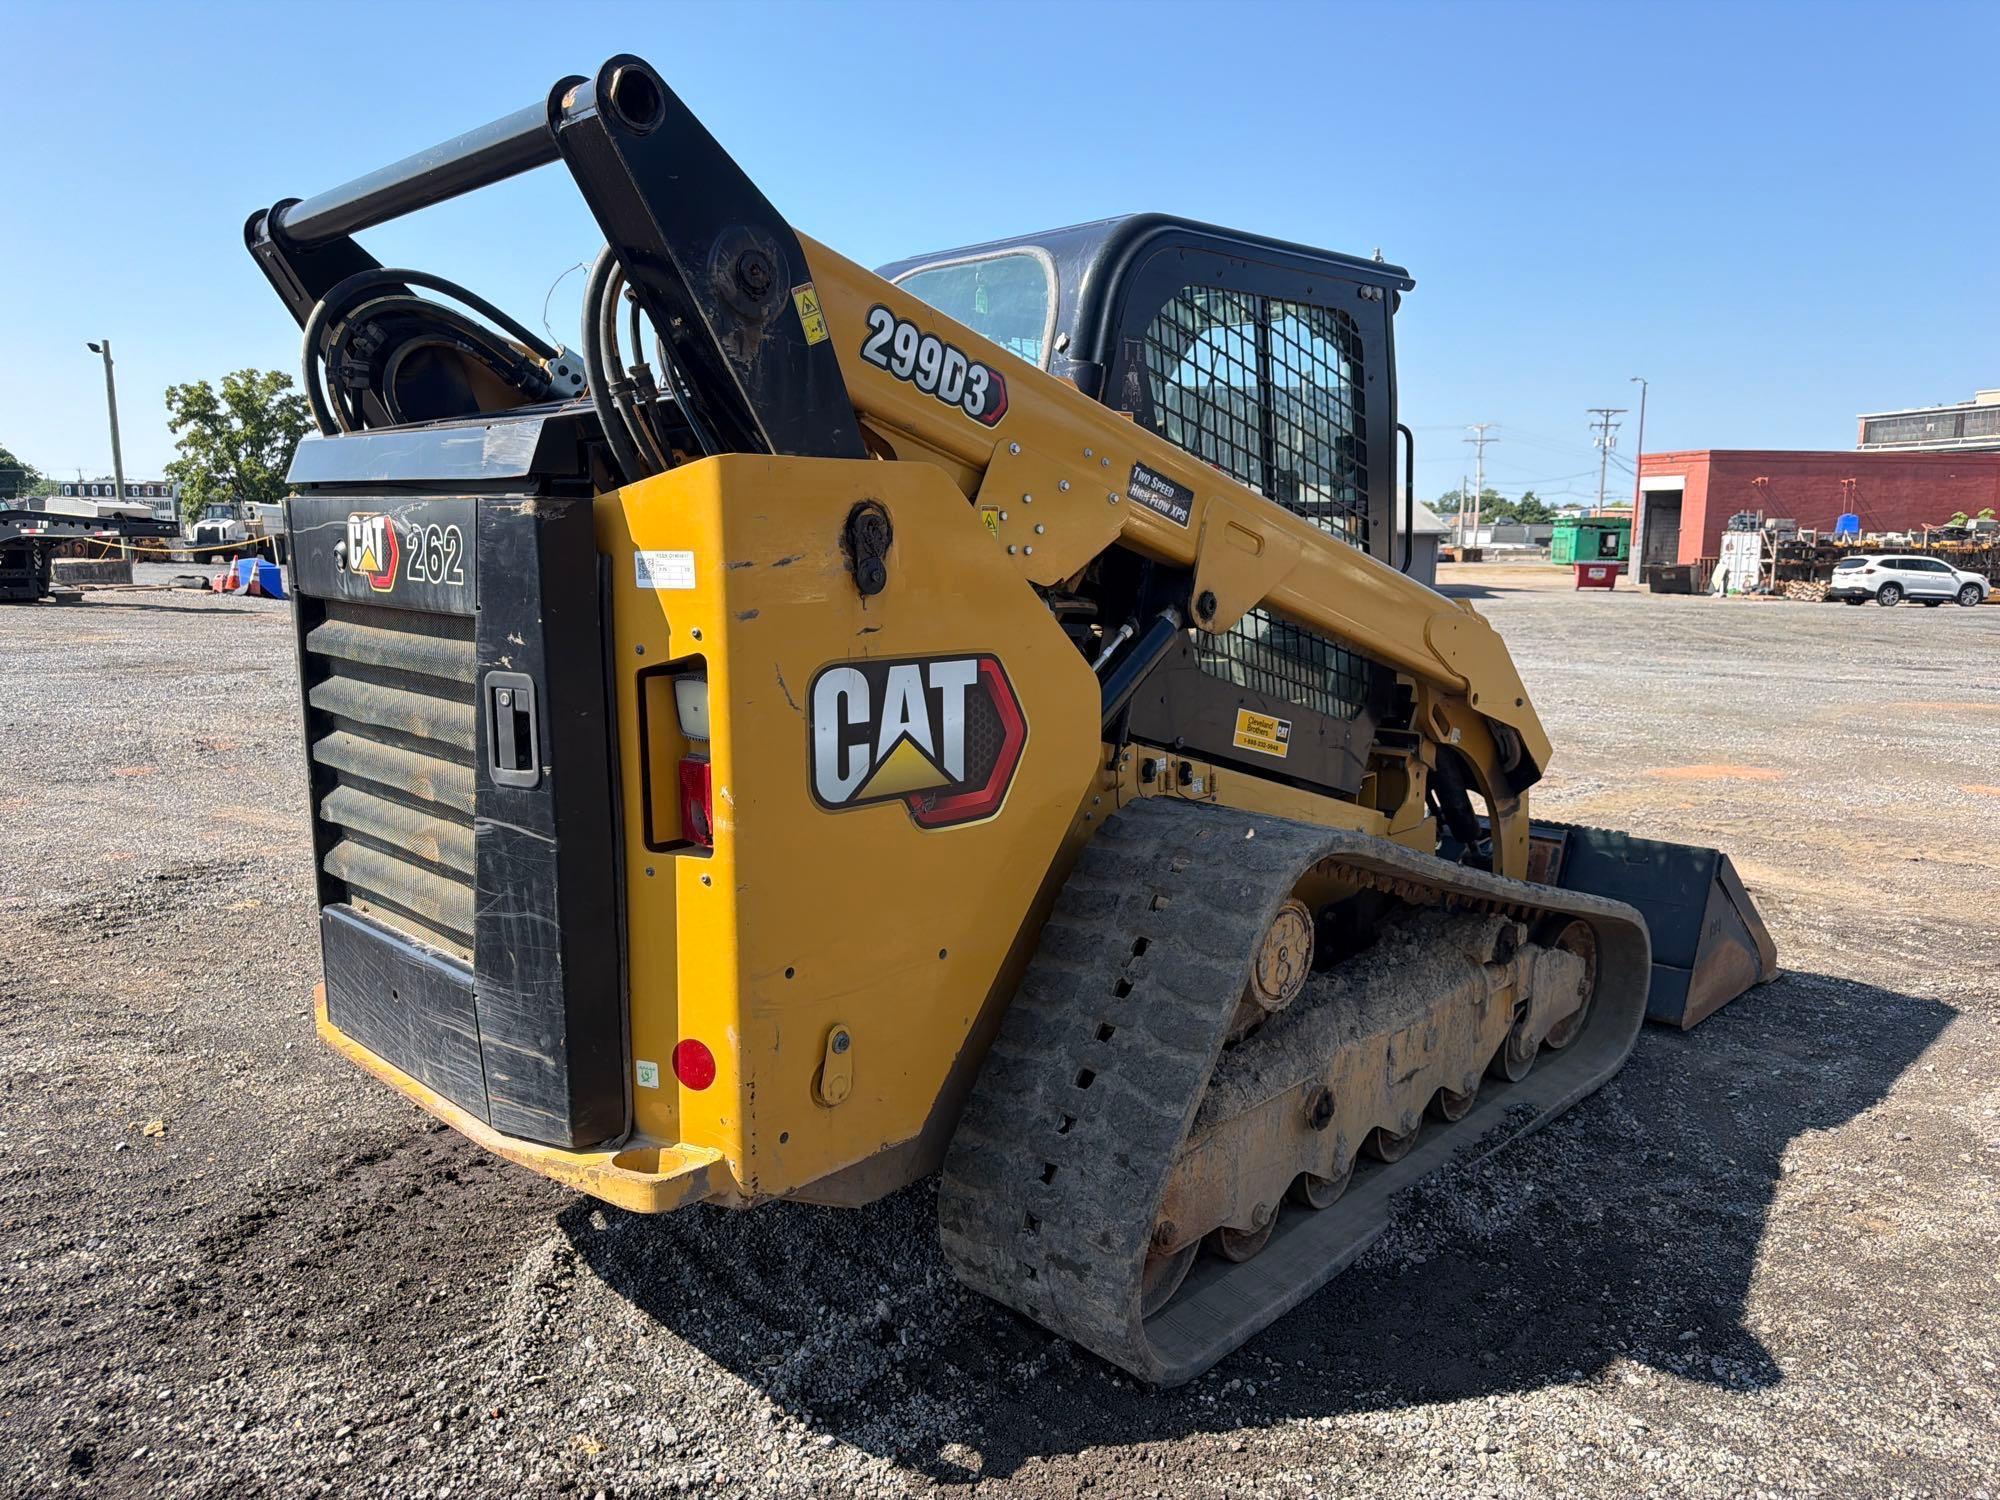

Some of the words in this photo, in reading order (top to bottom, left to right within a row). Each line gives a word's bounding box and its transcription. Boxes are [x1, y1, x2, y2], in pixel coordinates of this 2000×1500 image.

[863, 308, 990, 416] 299D3
[1133, 466, 1150, 485] TWO
[1151, 477, 1174, 497] SPEED
[1170, 504, 1187, 521] XPS
[348, 514, 385, 571] CAT
[406, 523, 464, 585] 262
[813, 659, 978, 804] CAT
[1247, 724, 1268, 736] Brothers
[1248, 716, 1274, 730] Cleveland
